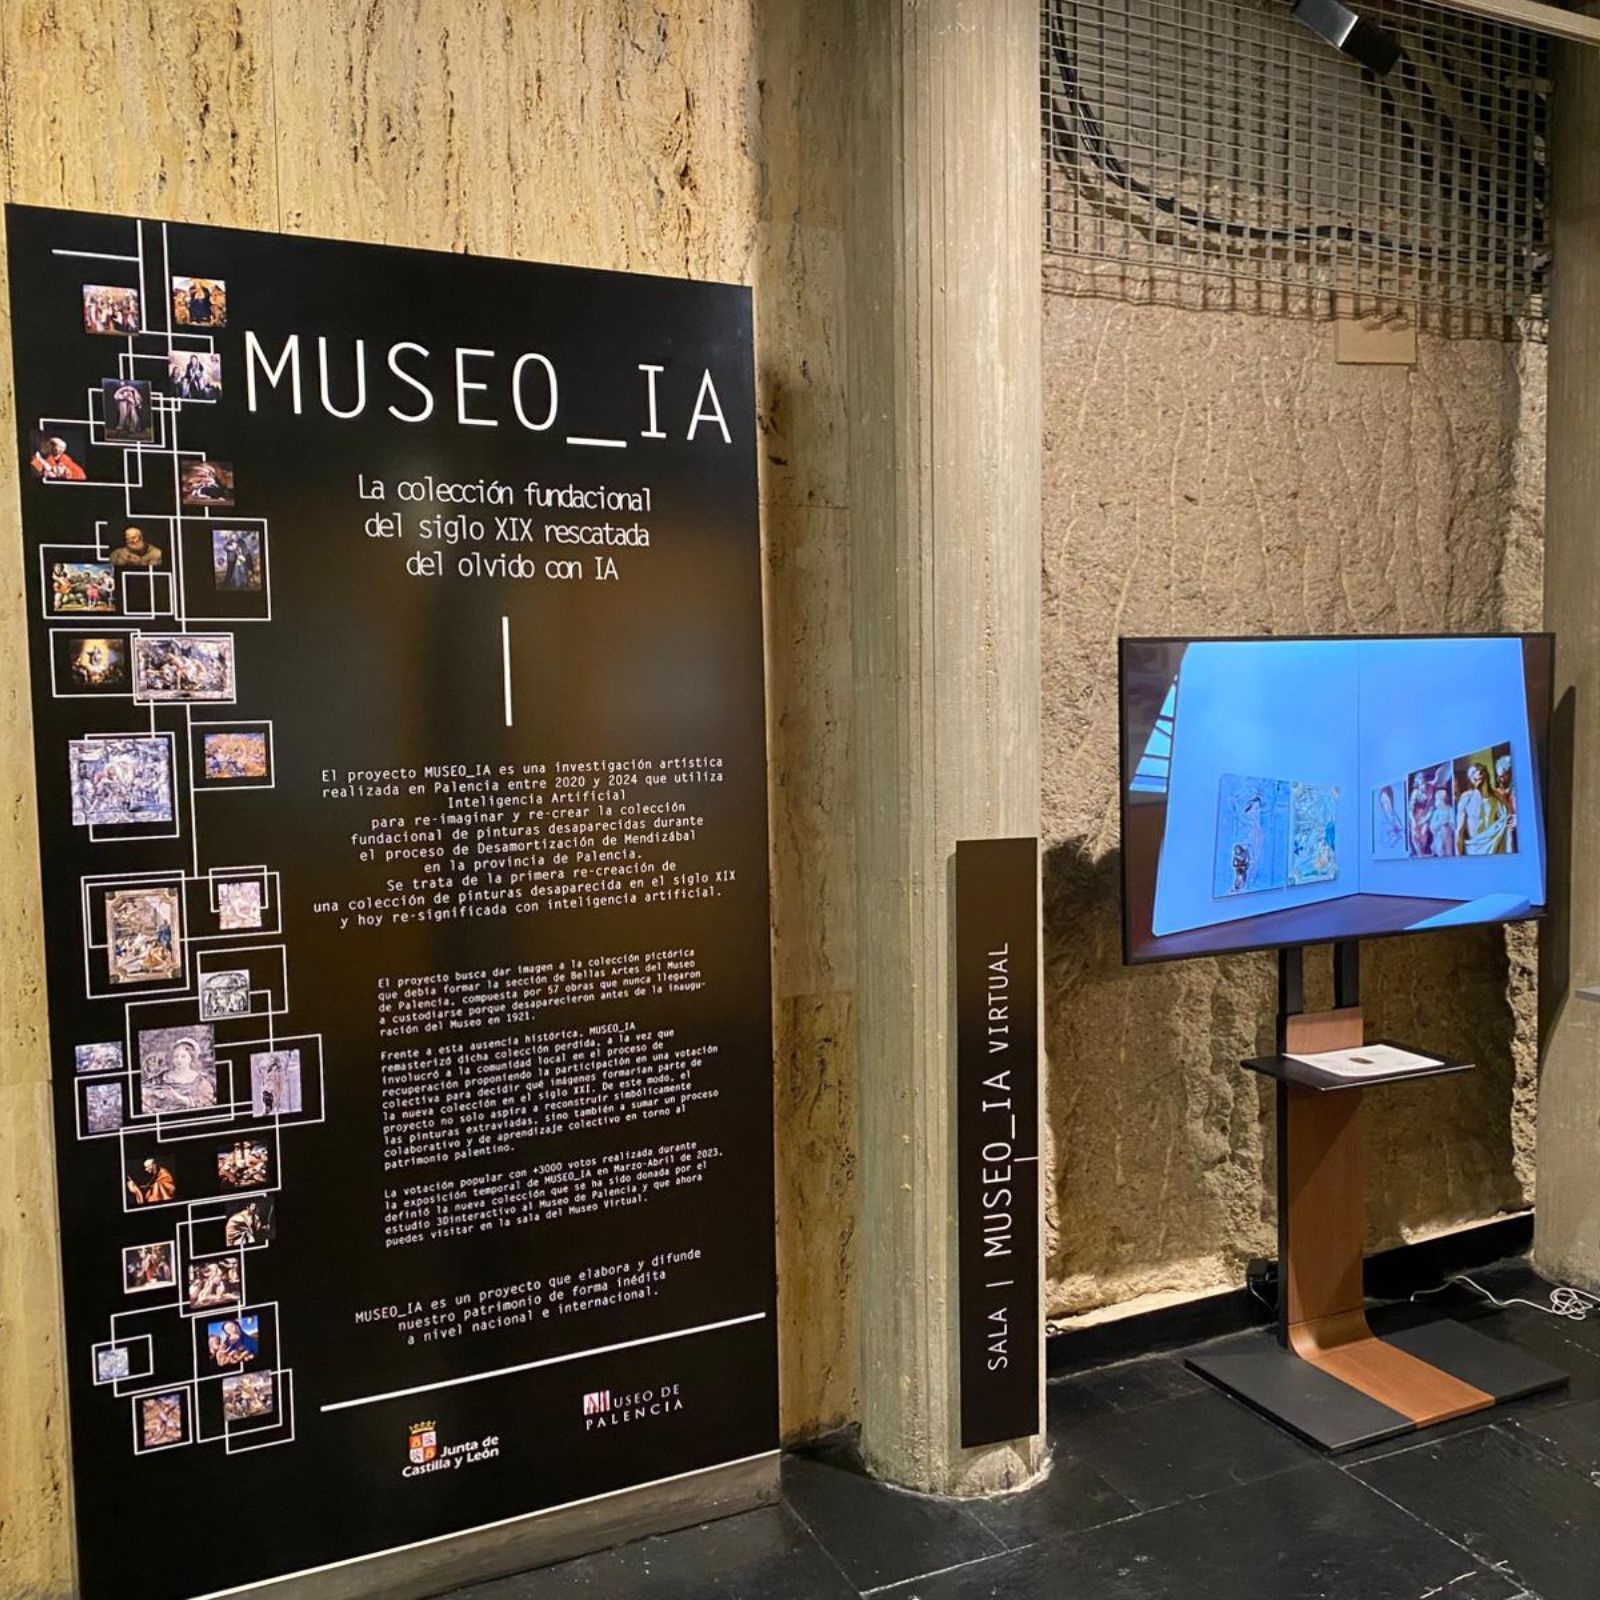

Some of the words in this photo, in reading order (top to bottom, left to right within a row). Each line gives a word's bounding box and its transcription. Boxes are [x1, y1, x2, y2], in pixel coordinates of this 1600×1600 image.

[245, 330, 731, 448] MUSEO_IA
[358, 474, 384, 499] La
[397, 476, 512, 504] colección
[523, 481, 650, 511] fundacional
[364, 512, 402, 537] del
[419, 514, 484, 544] siglo
[494, 516, 533, 541] XIX
[544, 522, 649, 546] rescatada
[406, 550, 442, 575] del
[458, 551, 534, 578] olvido
[545, 560, 582, 579] con
[595, 556, 618, 580] IA
[322, 769, 335, 781] El
[347, 767, 416, 783] proyecto
[424, 764, 491, 778] MUSEO_IA
[498, 765, 514, 774] es
[523, 764, 545, 773] una
[555, 758, 651, 772] investigación
[659, 756, 722, 768] artística
[322, 783, 399, 797] realizada
[408, 784, 424, 794] en
[434, 779, 498, 792] Palencia
[507, 778, 546, 789] entre
[555, 775, 585, 787] 2020
[592, 777, 600, 788] y
[608, 773, 637, 785] 2024
[645, 774, 666, 785] que
[674, 770, 722, 782] utiliza
[448, 792, 542, 808] Inteligencia
[550, 788, 624, 803] Artificial
[351, 828, 441, 844] fundacional
[451, 828, 468, 839] de
[476, 825, 539, 840] pinturas
[548, 818, 645, 834] desaparecidas
[653, 815, 703, 827] durante
[371, 817, 404, 830] para
[414, 811, 503, 825] re-imaginar
[512, 811, 519, 823] y
[529, 807, 589, 819] re-crear
[598, 804, 611, 815] la
[619, 801, 685, 813] colección
[359, 848, 374, 860] el
[385, 847, 444, 861] proceso
[452, 843, 468, 854] de
[477, 835, 594, 853] Desamortización
[602, 834, 616, 845] de
[624, 829, 694, 844] Mendizábal
[423, 863, 440, 871] en
[450, 859, 464, 870] la
[473, 854, 544, 872] provincia
[552, 852, 568, 863] de
[576, 848, 641, 862] Palencia.
[313, 902, 338, 911] una
[348, 894, 424, 908] colección
[433, 892, 449, 902] de
[458, 888, 522, 903] pinturas
[530, 879, 621, 896] desaparecida
[629, 879, 643, 887] en
[651, 874, 663, 886] el
[673, 872, 708, 886] siglo
[715, 870, 735, 881] XIX
[386, 879, 403, 890] Se
[412, 877, 452, 888] trata
[461, 874, 478, 884] de
[487, 872, 501, 883] la
[510, 869, 564, 884] primera
[662, 860, 675, 870] de
[340, 917, 348, 928] y
[357, 913, 382, 926] hoy
[392, 903, 506, 922] re-significada
[515, 902, 538, 912] con
[547, 892, 636, 909] inteligencia
[644, 885, 720, 901] artificial.
[988, 942, 1009, 1053] VIRTUAL
[982, 1070, 1016, 1257] MUSEO_IA
[355, 1301, 422, 1323] MUSEO_IA
[430, 1298, 446, 1309] es
[455, 1294, 470, 1304] un
[478, 1280, 540, 1302] proyecto
[548, 1274, 571, 1288] que
[578, 1263, 629, 1280] elabora
[637, 1260, 644, 1271] y
[651, 1248, 700, 1266] difunde
[398, 1312, 455, 1330] nuestro
[463, 1294, 541, 1320] patrimonio
[548, 1290, 563, 1301] de
[572, 1281, 608, 1296] forma
[616, 1270, 665, 1287] inédita
[407, 1335, 414, 1344] a
[423, 1323, 461, 1341] nivel
[472, 1309, 531, 1331] nacional
[541, 1309, 549, 1317] e
[558, 1286, 657, 1314] internacional.
[987, 1307, 1008, 1370] SALA
[660, 1384, 679, 1398] DE
[586, 1399, 683, 1431] PALENCIA
[402, 1458, 451, 1478] Castilla
[454, 1456, 463, 1469] y
[466, 1447, 499, 1463] León
[440, 1441, 479, 1458] Junta
[482, 1435, 499, 1448] de
